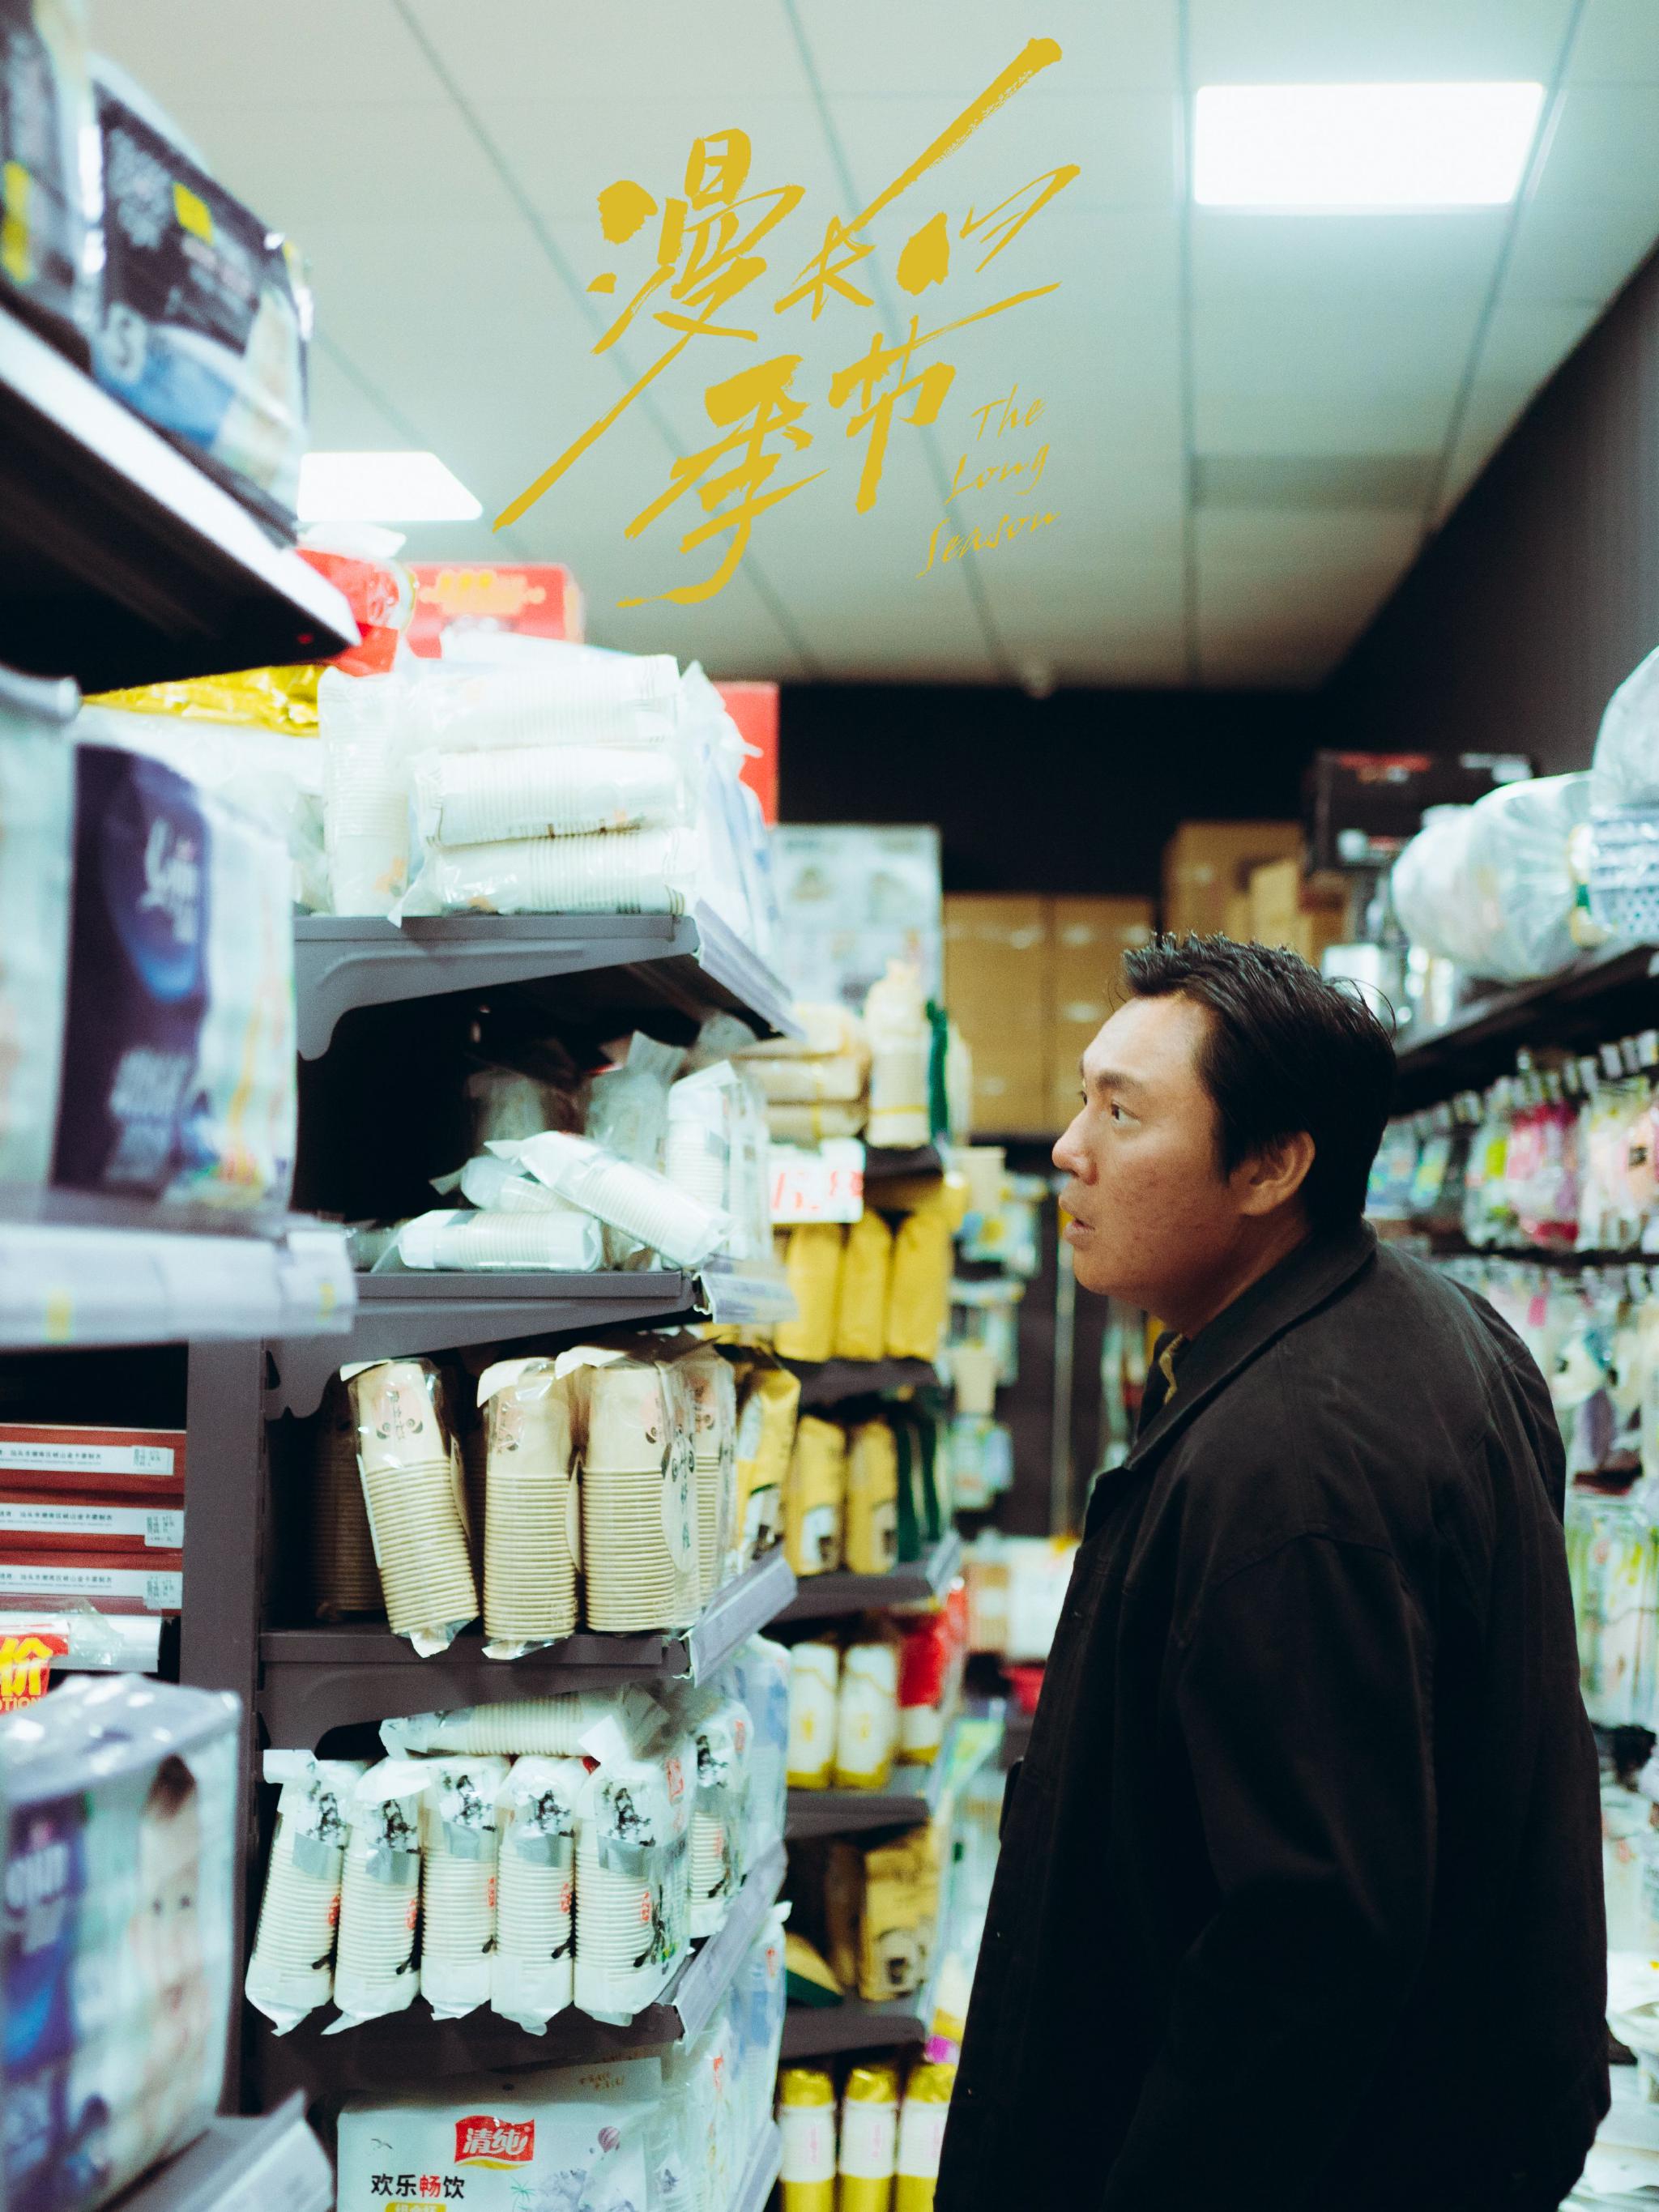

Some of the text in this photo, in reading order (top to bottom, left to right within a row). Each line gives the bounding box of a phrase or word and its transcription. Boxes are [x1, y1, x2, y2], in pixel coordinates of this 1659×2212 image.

[463, 2128, 529, 2156] 清纯
[371, 2173, 465, 2199] 欢乐畅饮
